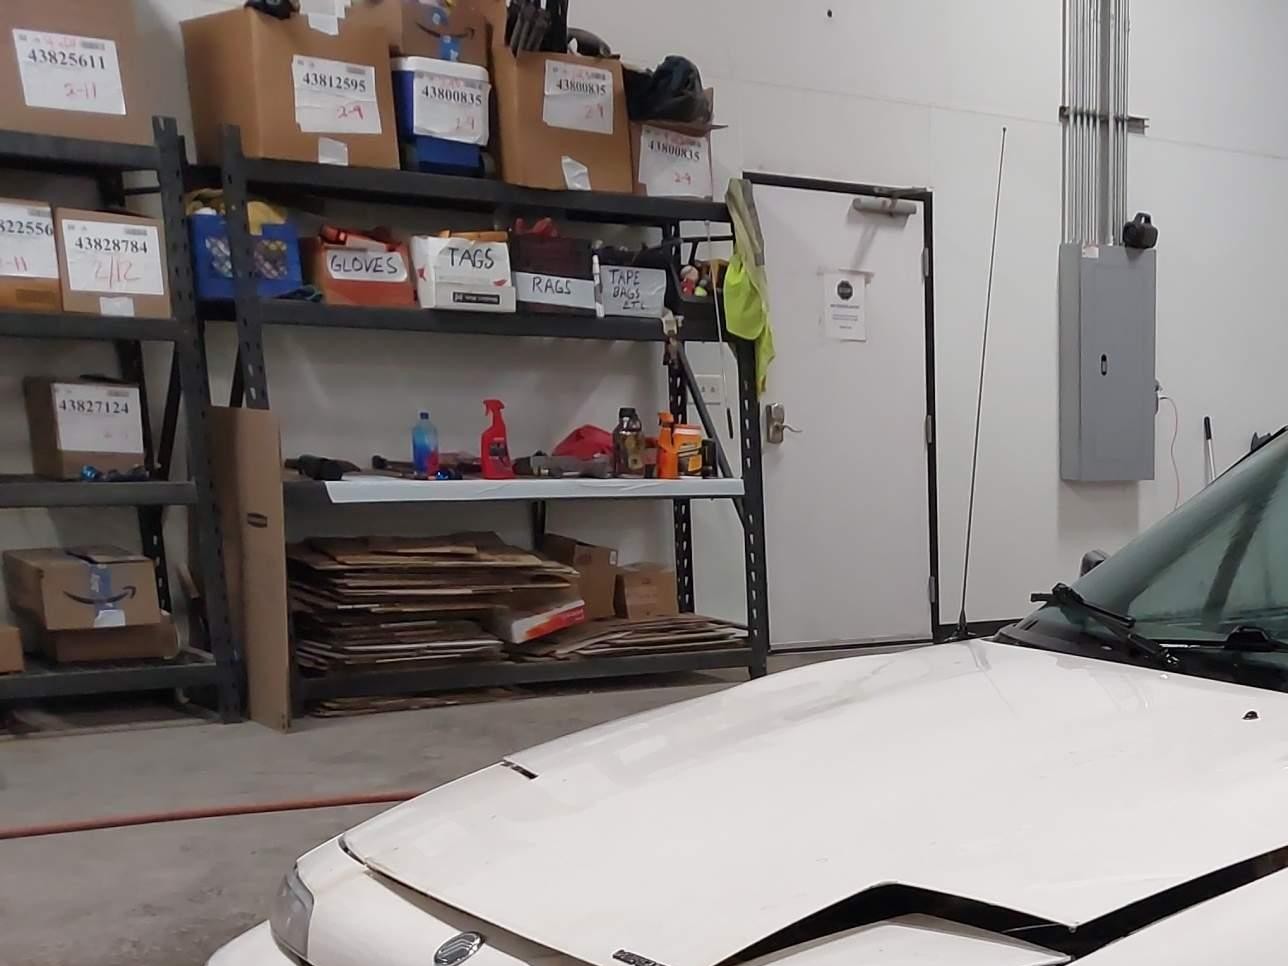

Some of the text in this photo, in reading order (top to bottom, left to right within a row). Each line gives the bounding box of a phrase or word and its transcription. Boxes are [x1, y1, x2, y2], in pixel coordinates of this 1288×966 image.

[28, 47, 104, 70] 43825611
[303, 71, 367, 93] 43812595
[422, 84, 483, 105] 43800835
[337, 104, 364, 121] 2-9
[75, 236, 148, 254] 43828784
[330, 254, 398, 274] GLOVES
[448, 246, 495, 270] TAGS
[532, 275, 571, 295] RAGS
[608, 268, 640, 286] TAPE
[612, 286, 640, 300] BAGS
[60, 400, 129, 414] 43827124
